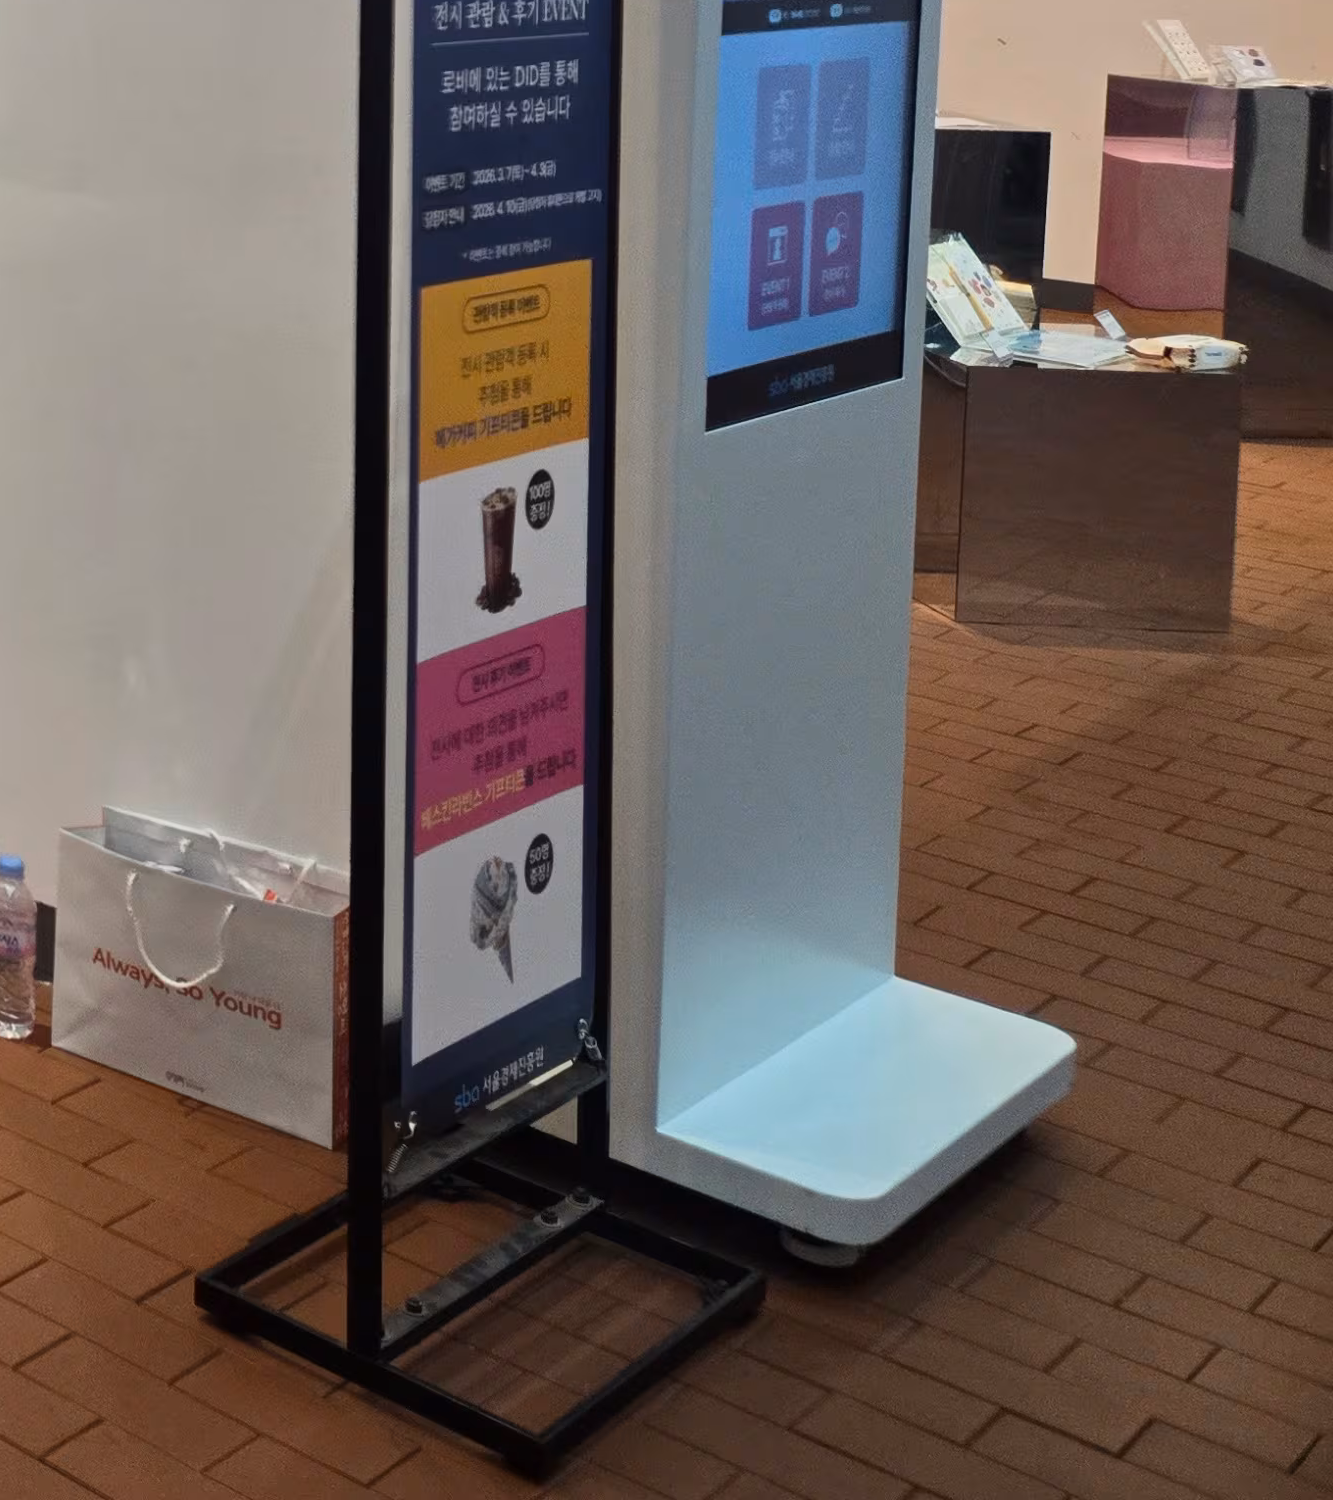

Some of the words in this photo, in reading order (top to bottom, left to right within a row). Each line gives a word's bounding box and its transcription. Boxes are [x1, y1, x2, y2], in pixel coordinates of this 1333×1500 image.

[433, 3, 462, 31] 전시
[465, 1, 496, 29] 관람
[498, 2, 510, 25] &
[440, 66, 482, 94] 로비에
[484, 65, 511, 92] 있는
[514, 62, 551, 88] DID를
[554, 58, 579, 87] 통해
[449, 101, 502, 133] 참여하실
[505, 102, 519, 125] 수
[522, 94, 571, 124] 있습니다
[529, 481, 551, 501] 100명
[530, 500, 551, 522] 증정!
[529, 842, 550, 864] 50명
[210, 987, 283, 1030] Young
[454, 1084, 480, 1113] sba
